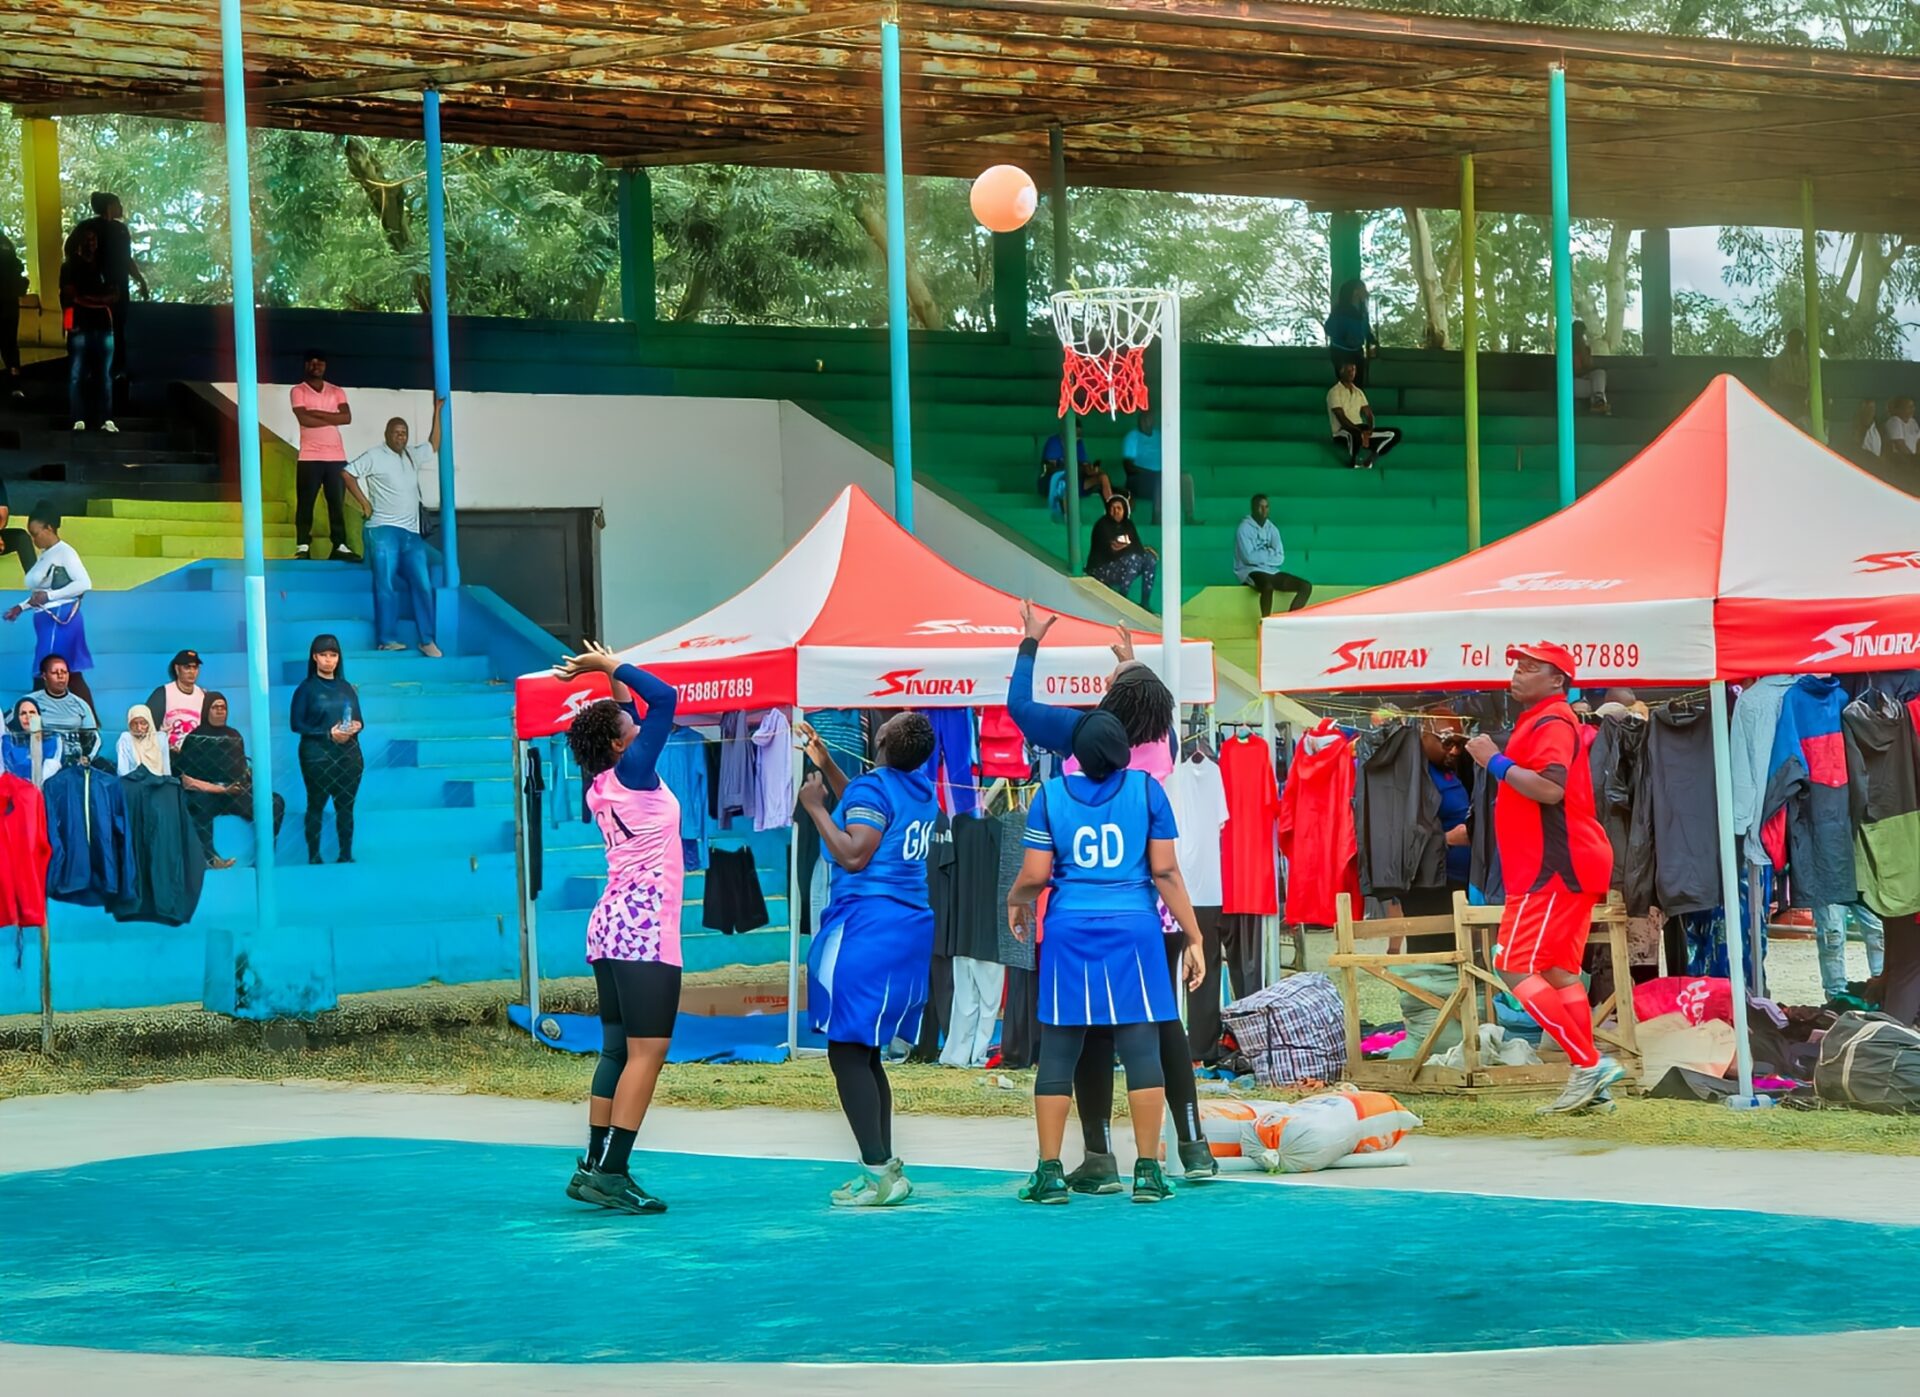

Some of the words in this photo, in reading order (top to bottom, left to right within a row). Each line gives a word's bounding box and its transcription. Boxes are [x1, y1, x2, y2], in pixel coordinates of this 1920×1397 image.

[1318, 638, 1432, 676] SINORAY
[865, 668, 978, 697] SINORAY
[1046, 676, 1111, 694] 07588
[1073, 823, 1124, 869] GD
